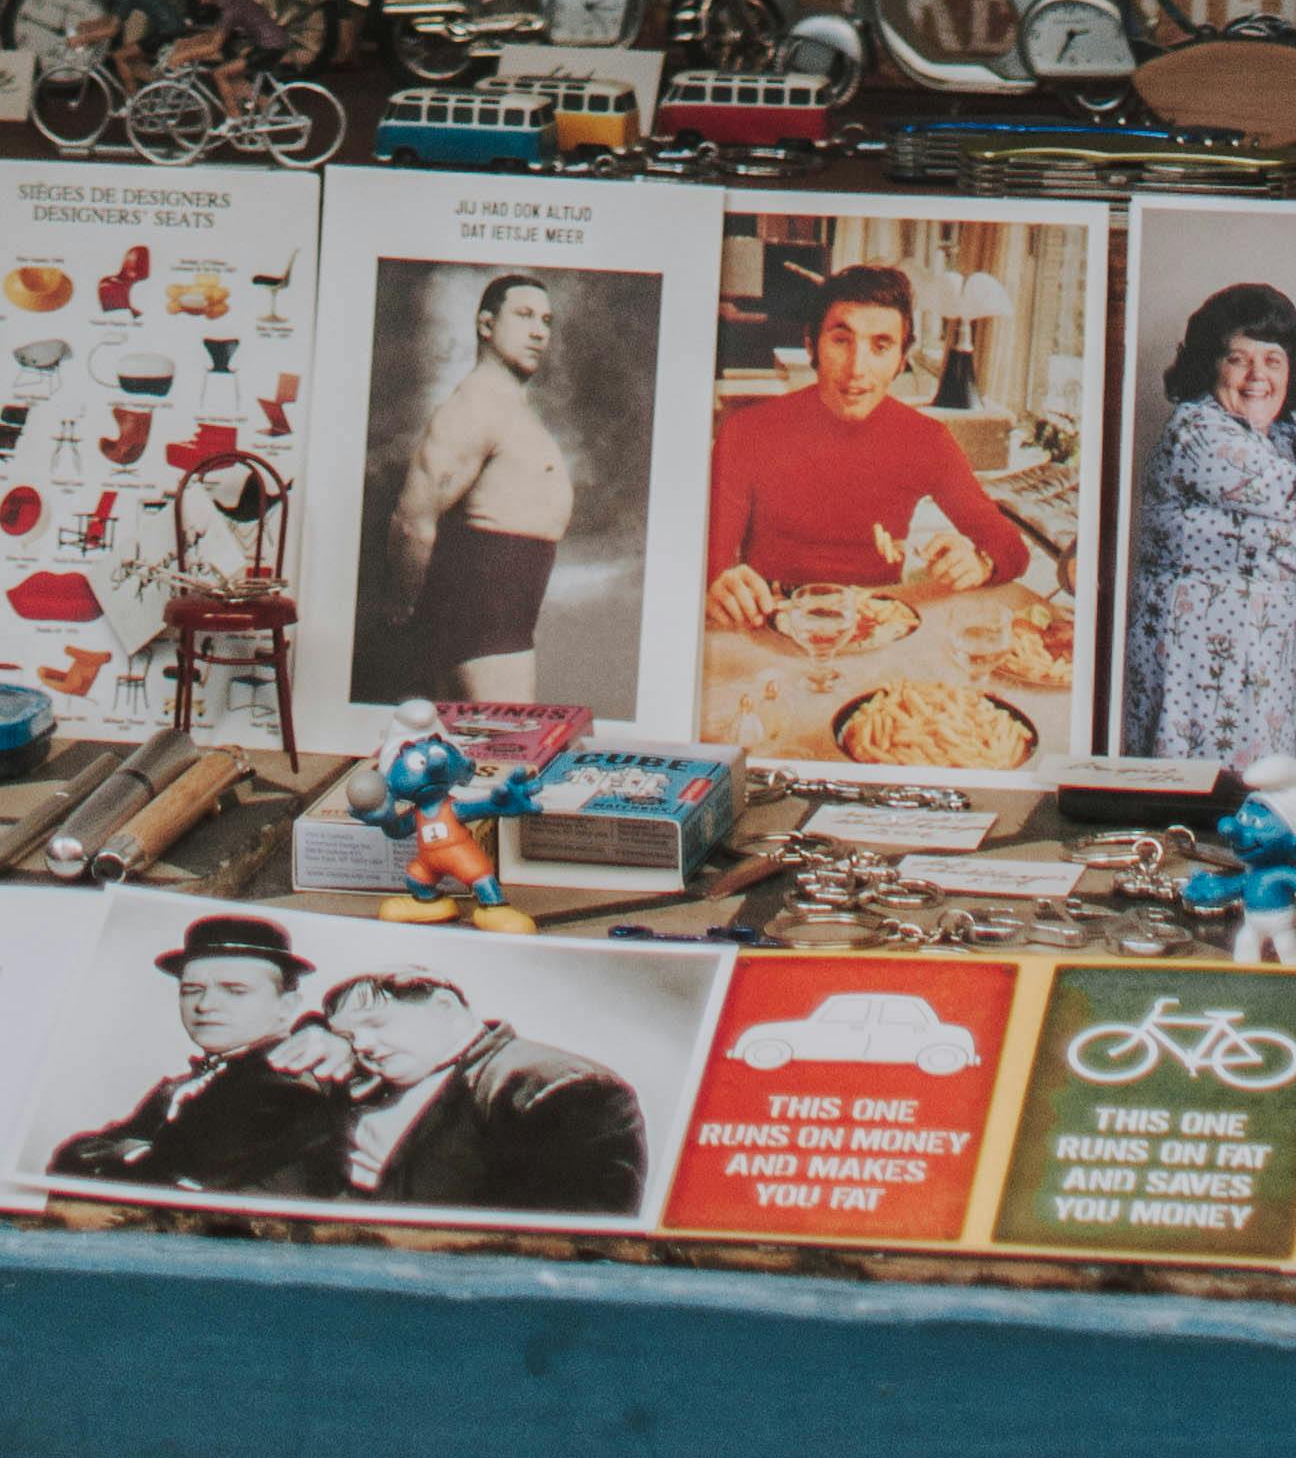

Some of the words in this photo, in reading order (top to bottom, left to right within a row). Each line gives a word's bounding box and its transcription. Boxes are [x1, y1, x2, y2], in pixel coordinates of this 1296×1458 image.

[16, 183, 86, 202] SIÈGES
[91, 187, 116, 203] DE
[122, 188, 232, 209] DESIGNERS
[153, 210, 215, 229] SEATS
[455, 200, 477, 215] JIJ
[482, 202, 509, 216] HAD
[514, 203, 540, 218] OOK
[546, 205, 592, 223] ALTIJD
[460, 223, 486, 239] DAT
[492, 225, 540, 242] IETSJE
[546, 228, 585, 244] MEER
[573, 752, 693, 771] CUBE
[768, 1095, 841, 1120] THIS
[851, 1100, 918, 1124] ONE
[1095, 1106, 1171, 1133] THIS
[1179, 1112, 1249, 1137] ONE
[697, 1122, 789, 1147] RUNS
[797, 1126, 841, 1149] ON
[849, 1129, 970, 1155] MONEY
[1056, 1135, 1149, 1163] RUNS
[1158, 1141, 1204, 1167] ON
[1215, 1145, 1273, 1171] FAT
[725, 1153, 799, 1177] AND
[806, 1157, 927, 1183] MAKES
[754, 1183, 822, 1208] YOU
[829, 1188, 886, 1212] FAT
[1062, 1167, 1135, 1193] AND
[1144, 1171, 1253, 1199] SAVES
[1054, 1195, 1122, 1223] YOU
[1129, 1201, 1253, 1230] MONEY
